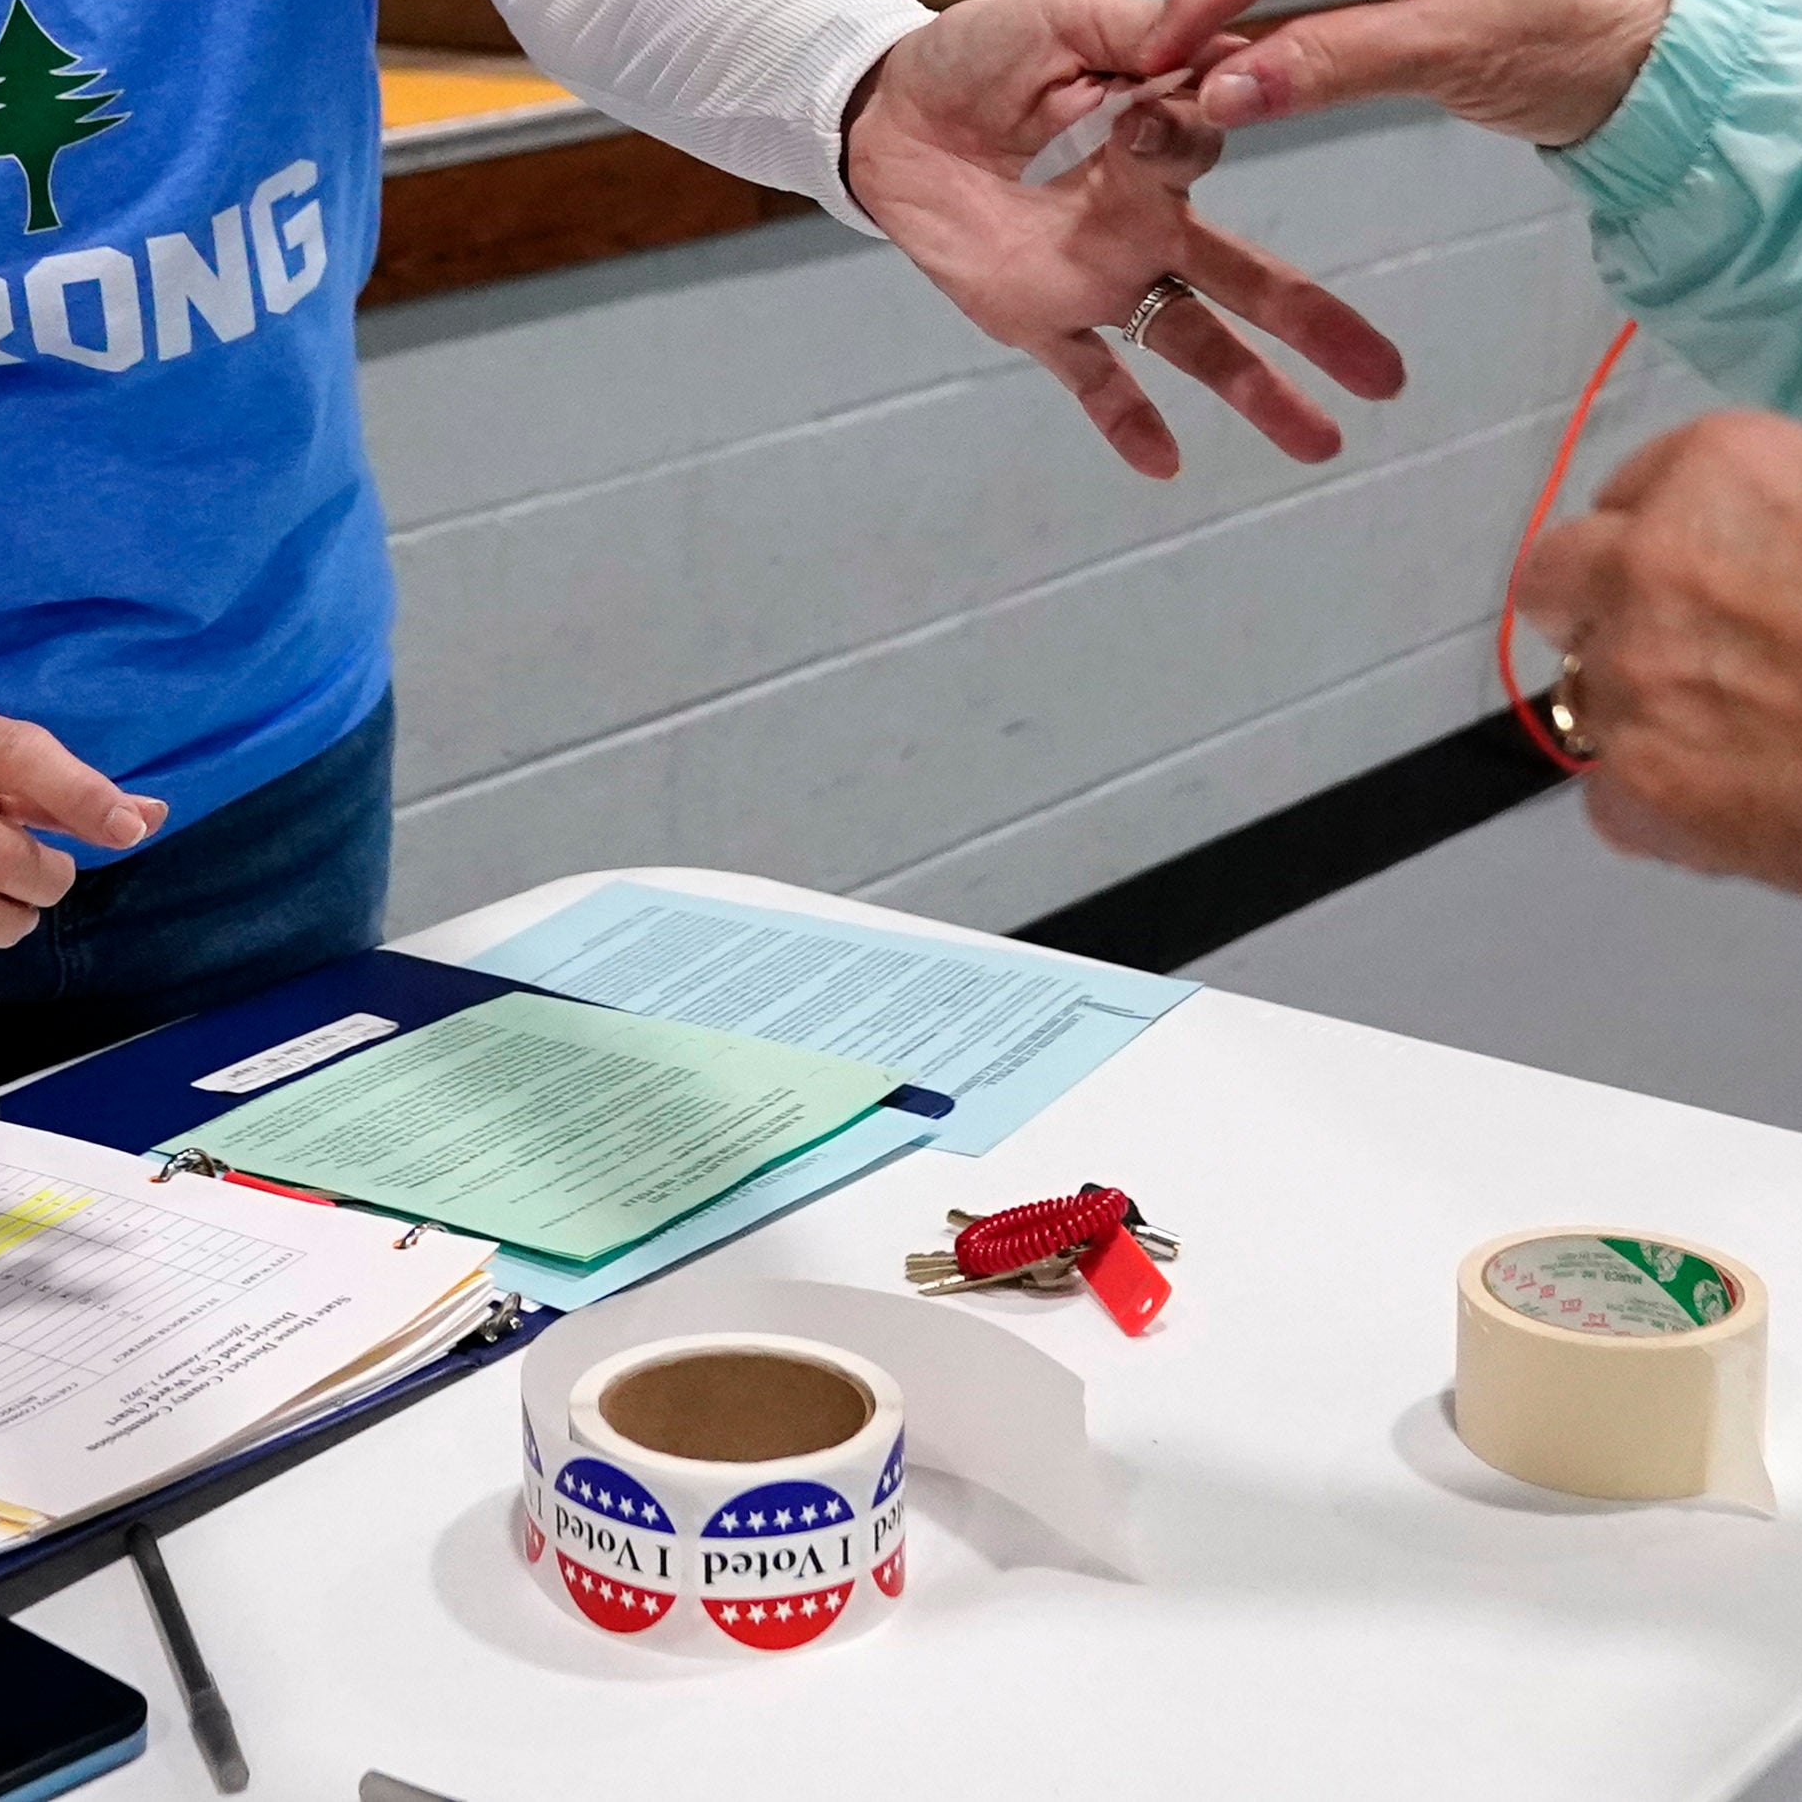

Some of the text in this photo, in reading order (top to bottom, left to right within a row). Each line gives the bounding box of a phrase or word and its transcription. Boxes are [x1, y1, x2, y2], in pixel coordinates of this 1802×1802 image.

[271, 1315, 319, 1343] House
[312, 1294, 354, 1318] State
[104, 1310, 299, 1428] District and City Ward Chart
[554, 1503, 672, 1578] I Voted
[702, 1535, 851, 1584] I Voted
